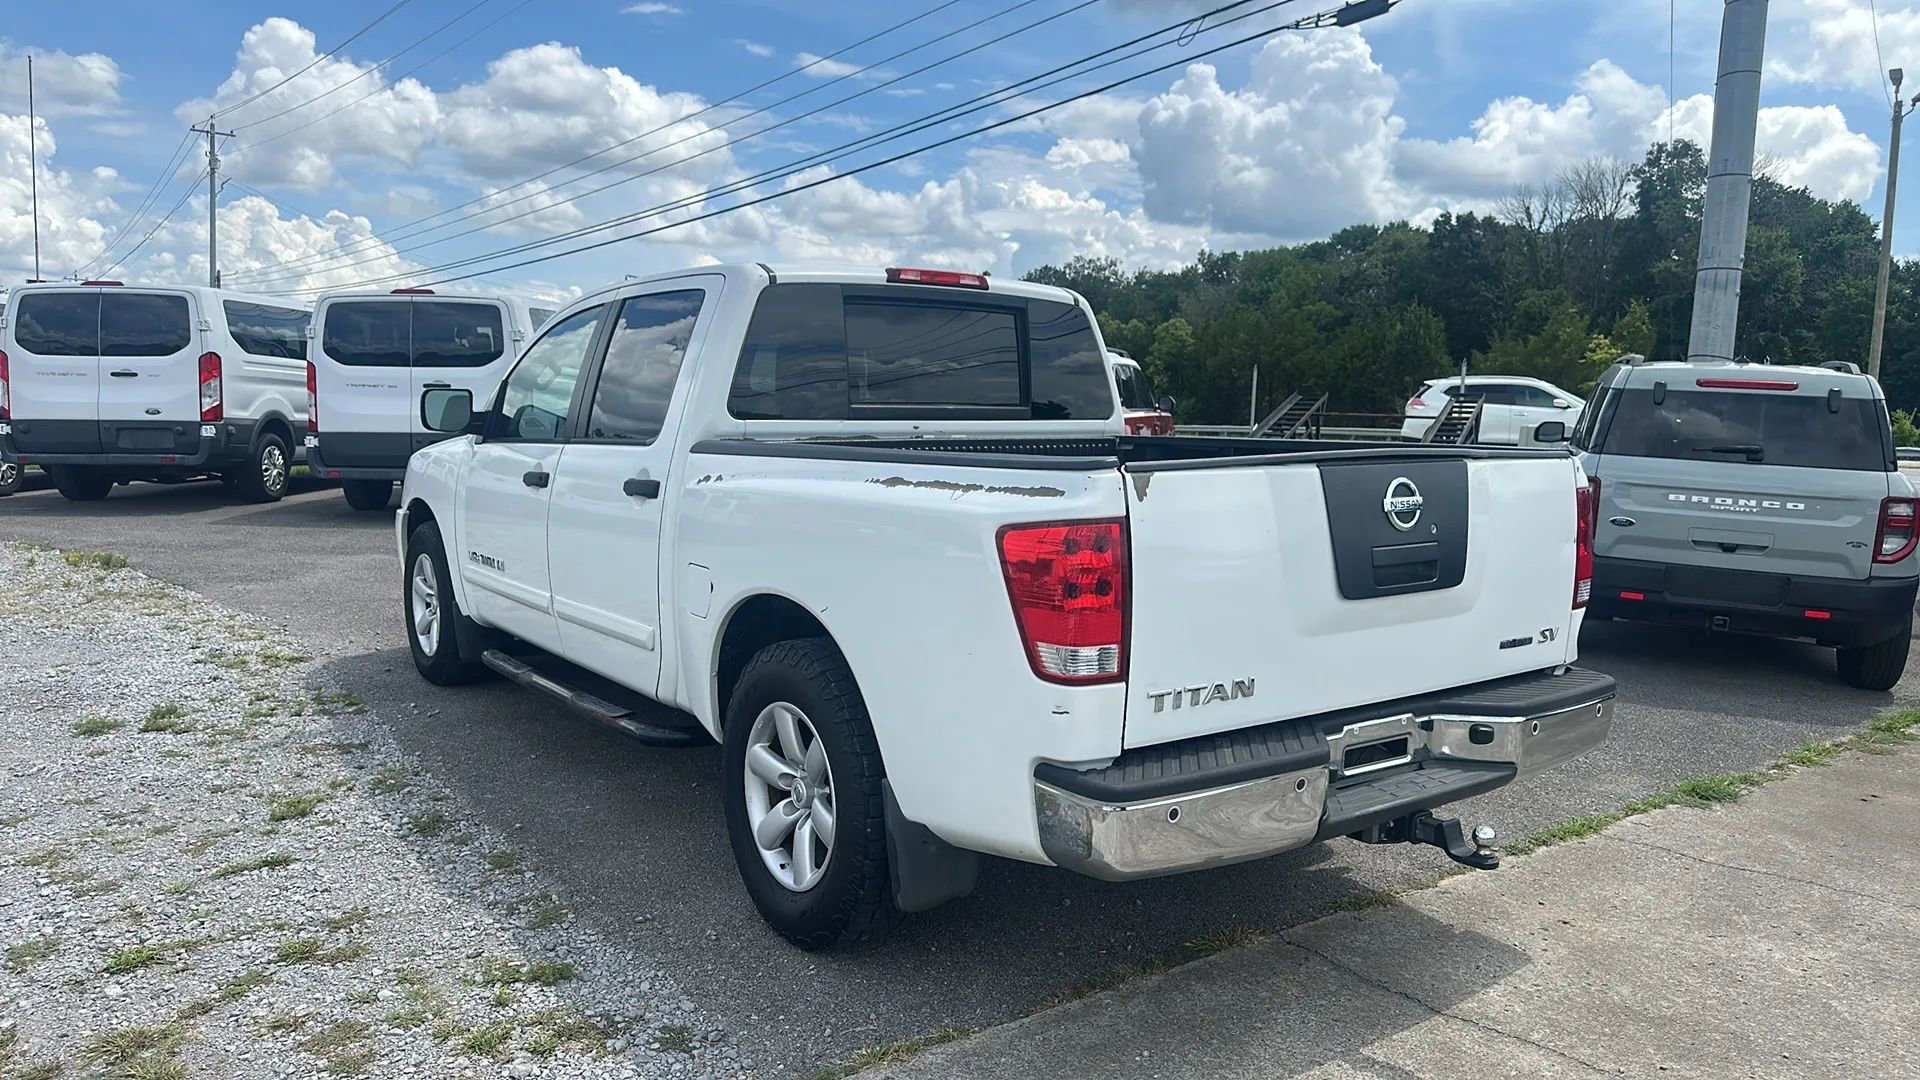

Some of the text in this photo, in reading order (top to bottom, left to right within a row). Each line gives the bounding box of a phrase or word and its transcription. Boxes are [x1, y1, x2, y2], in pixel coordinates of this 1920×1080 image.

[1390, 499, 1421, 510] NISSAN
[1668, 493, 1805, 510] BRONCO
[1710, 504, 1760, 513] SPORT
[1537, 626, 1560, 644] SV
[1147, 676, 1255, 713] TITAN
